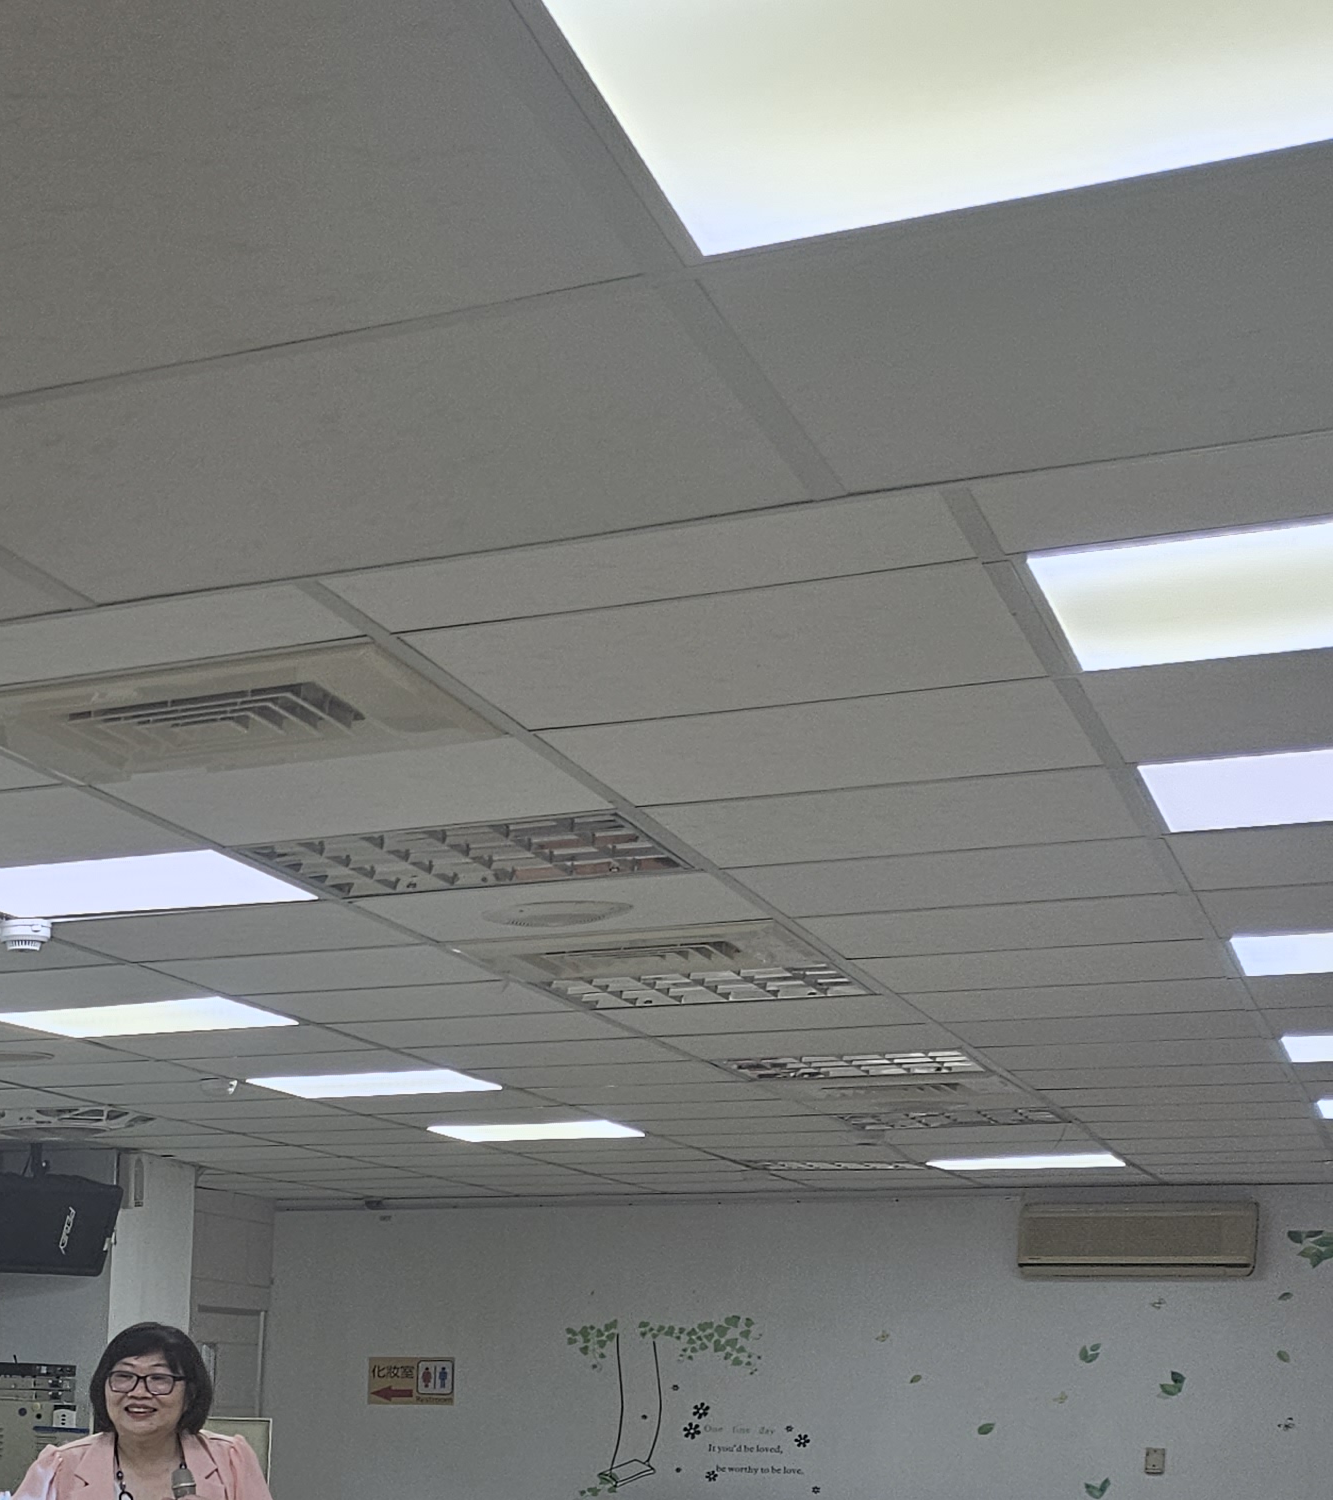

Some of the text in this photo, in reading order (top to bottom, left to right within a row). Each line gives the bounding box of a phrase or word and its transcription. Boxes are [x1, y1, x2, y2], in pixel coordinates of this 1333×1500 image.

[744, 1444, 755, 1453] be
[756, 1444, 783, 1455] loved,
[715, 1464, 726, 1473] be
[728, 1465, 758, 1476] worthy
[760, 1466, 770, 1474] to
[771, 1466, 781, 1475] be
